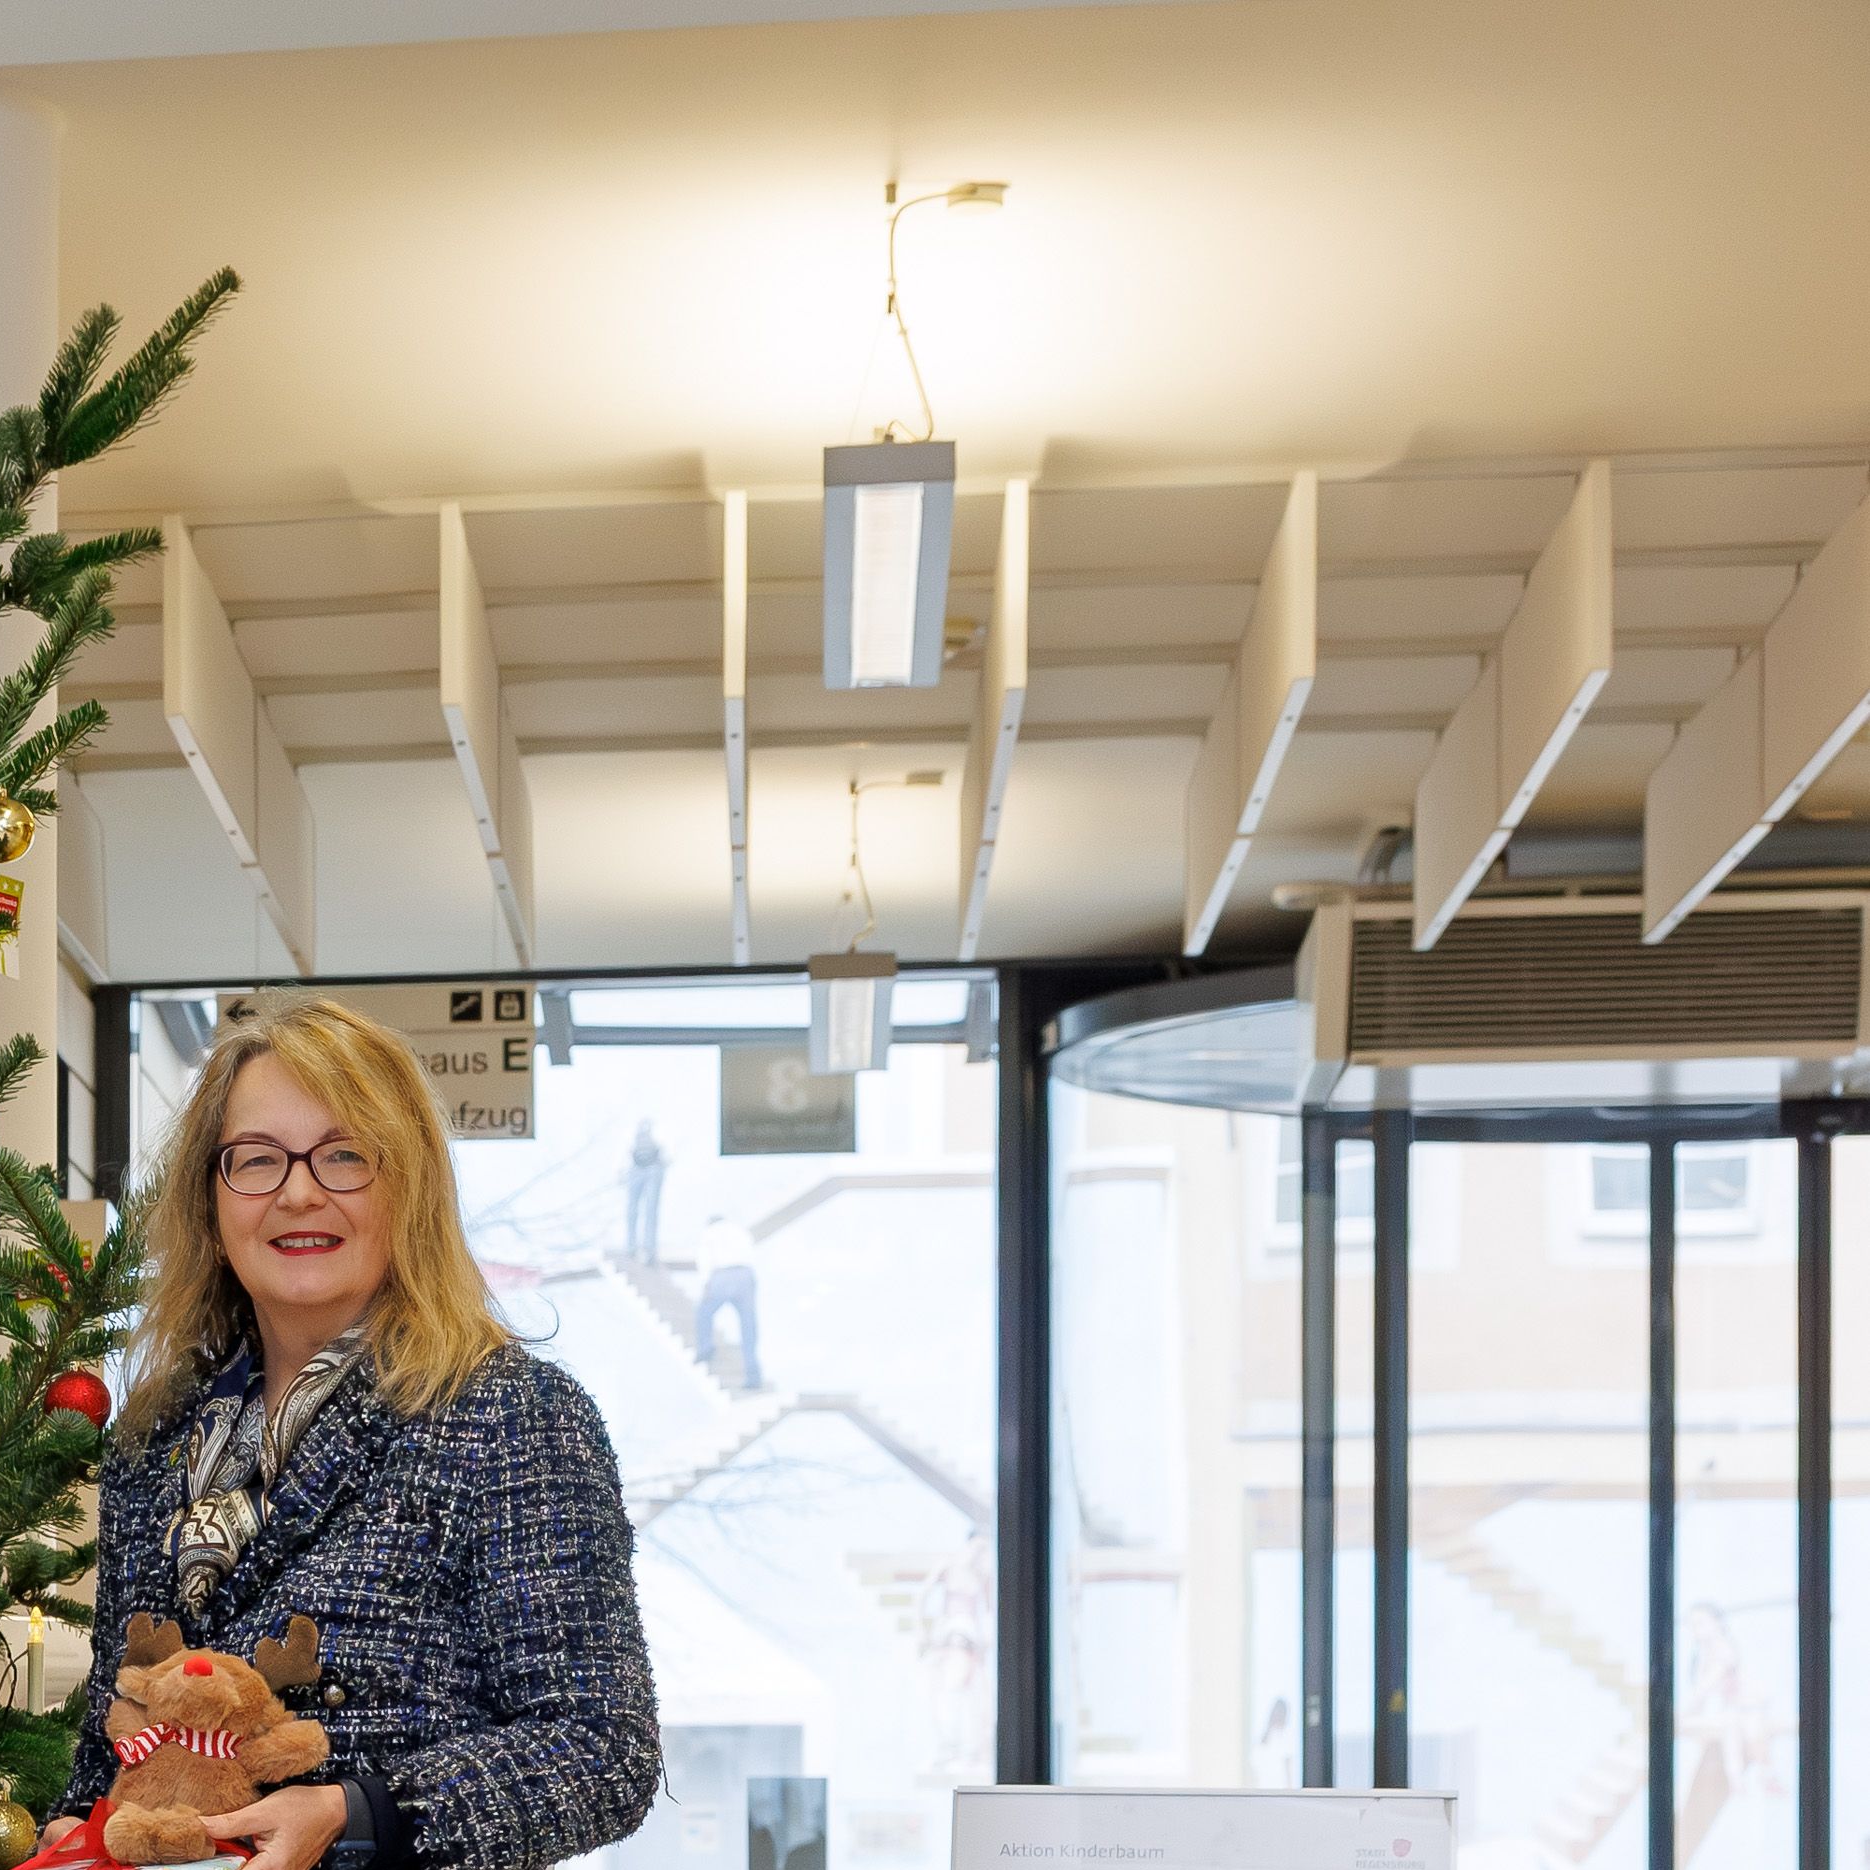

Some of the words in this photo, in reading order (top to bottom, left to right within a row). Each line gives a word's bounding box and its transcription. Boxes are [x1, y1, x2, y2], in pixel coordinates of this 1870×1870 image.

[424, 1054, 488, 1074] aus
[502, 1038, 528, 1071] E
[1000, 1843, 1054, 1858] Aktion
[1060, 1843, 1164, 1860] Kinderbaum
